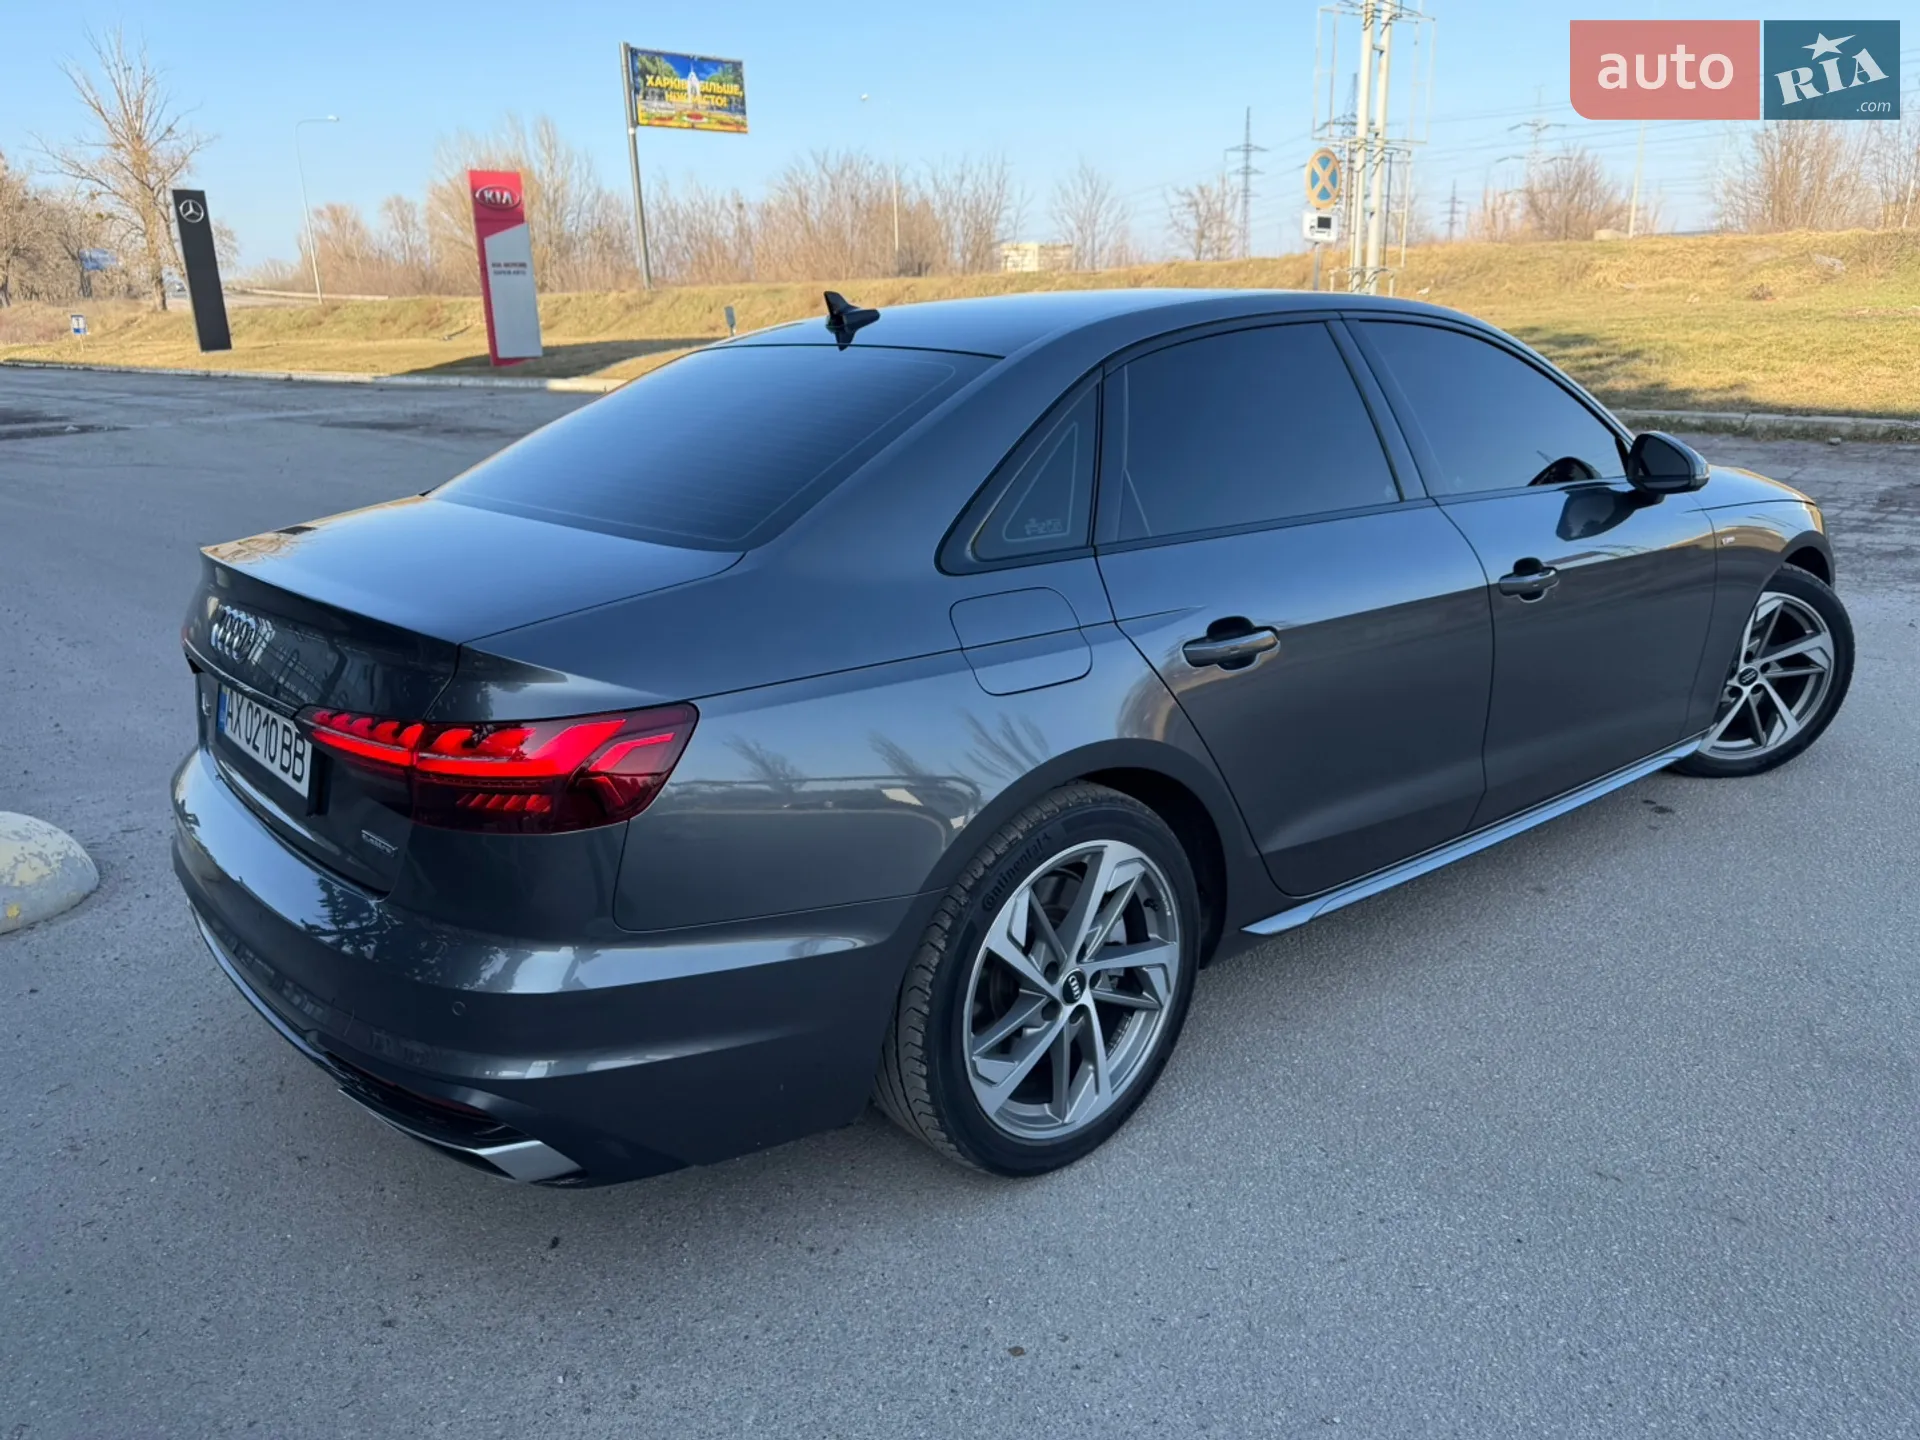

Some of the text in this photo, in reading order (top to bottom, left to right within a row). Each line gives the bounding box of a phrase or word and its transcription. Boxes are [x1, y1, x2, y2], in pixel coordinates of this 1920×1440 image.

[646, 74, 689, 91] ХАРКІВ
[483, 189, 513, 205] KIA
[226, 689, 306, 784] AX 0210 BB
